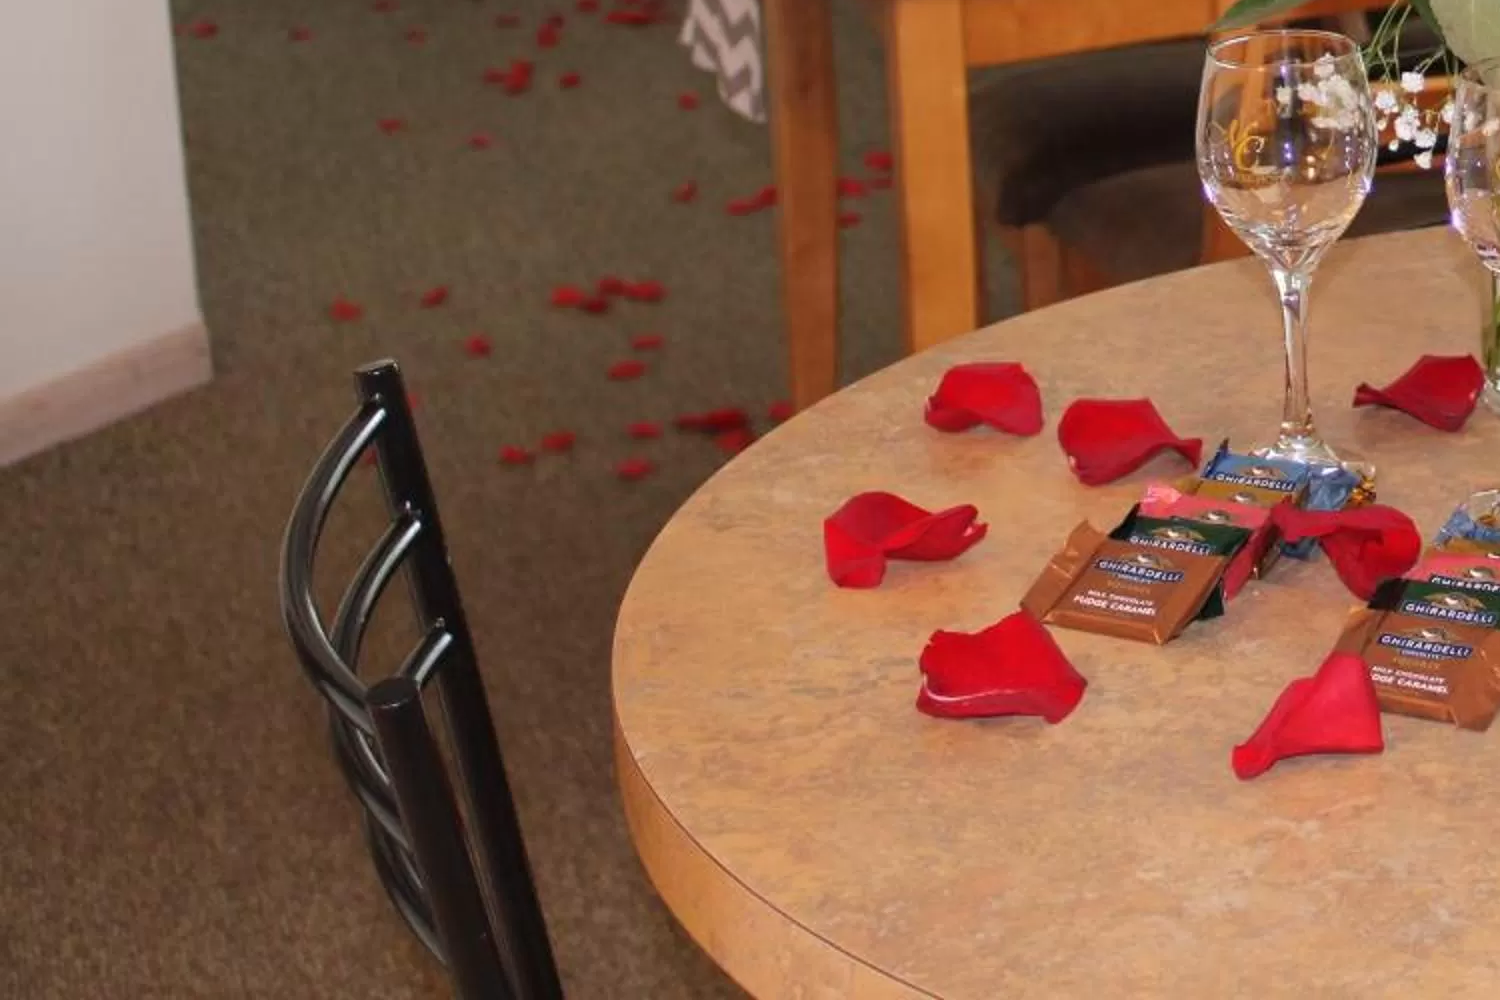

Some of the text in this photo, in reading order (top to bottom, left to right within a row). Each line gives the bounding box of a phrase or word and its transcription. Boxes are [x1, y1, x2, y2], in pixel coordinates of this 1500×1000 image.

[1215, 472, 1294, 491] GHIRARDELLI
[1129, 535, 1212, 556] GHIRARDELLI
[1099, 560, 1181, 581] GHIRARDELLI
[1073, 595, 1157, 617] FUDGE CARAMEL
[1404, 603, 1494, 624] GHIRARDELLI
[1380, 635, 1470, 656] GHIRARDELLI
[1396, 677, 1449, 695] CARAMEL
